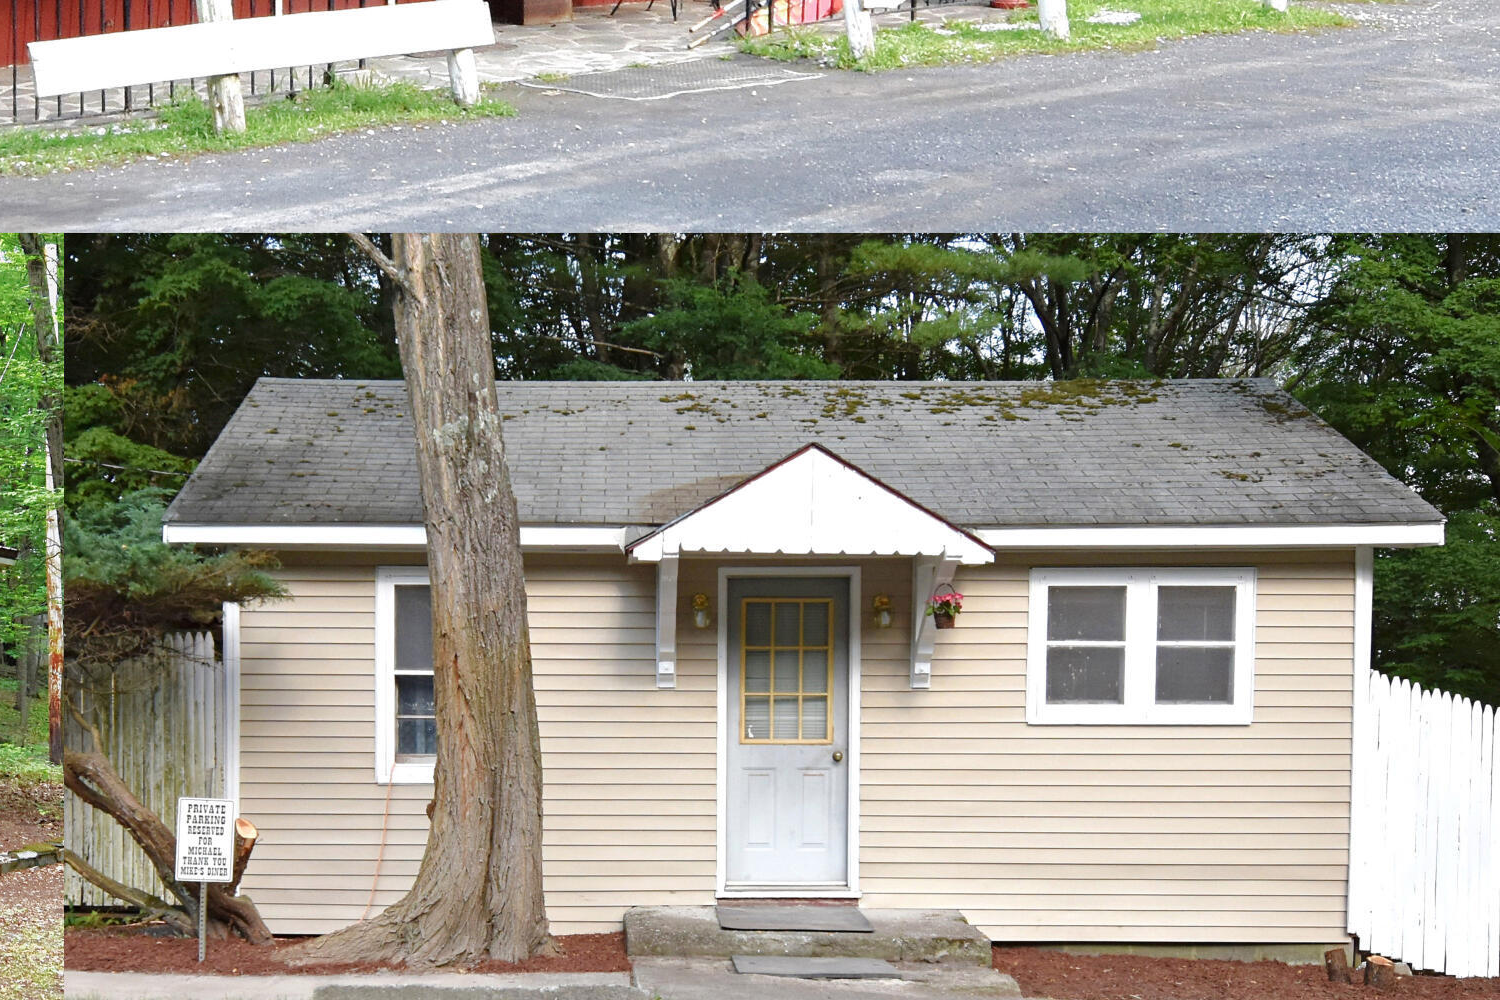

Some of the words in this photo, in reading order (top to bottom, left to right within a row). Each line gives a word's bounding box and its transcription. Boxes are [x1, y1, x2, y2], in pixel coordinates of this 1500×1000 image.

[187, 803, 226, 814] PRIVATE
[186, 814, 226, 824] PARKING
[187, 825, 225, 836] RESERVED
[198, 836, 212, 845] FOR
[187, 846, 222, 856] MICHAEL
[182, 856, 209, 865] THANK
[212, 857, 227, 866] YOU
[180, 866, 205, 876] MIKE'S
[207, 867, 228, 876] DINER
